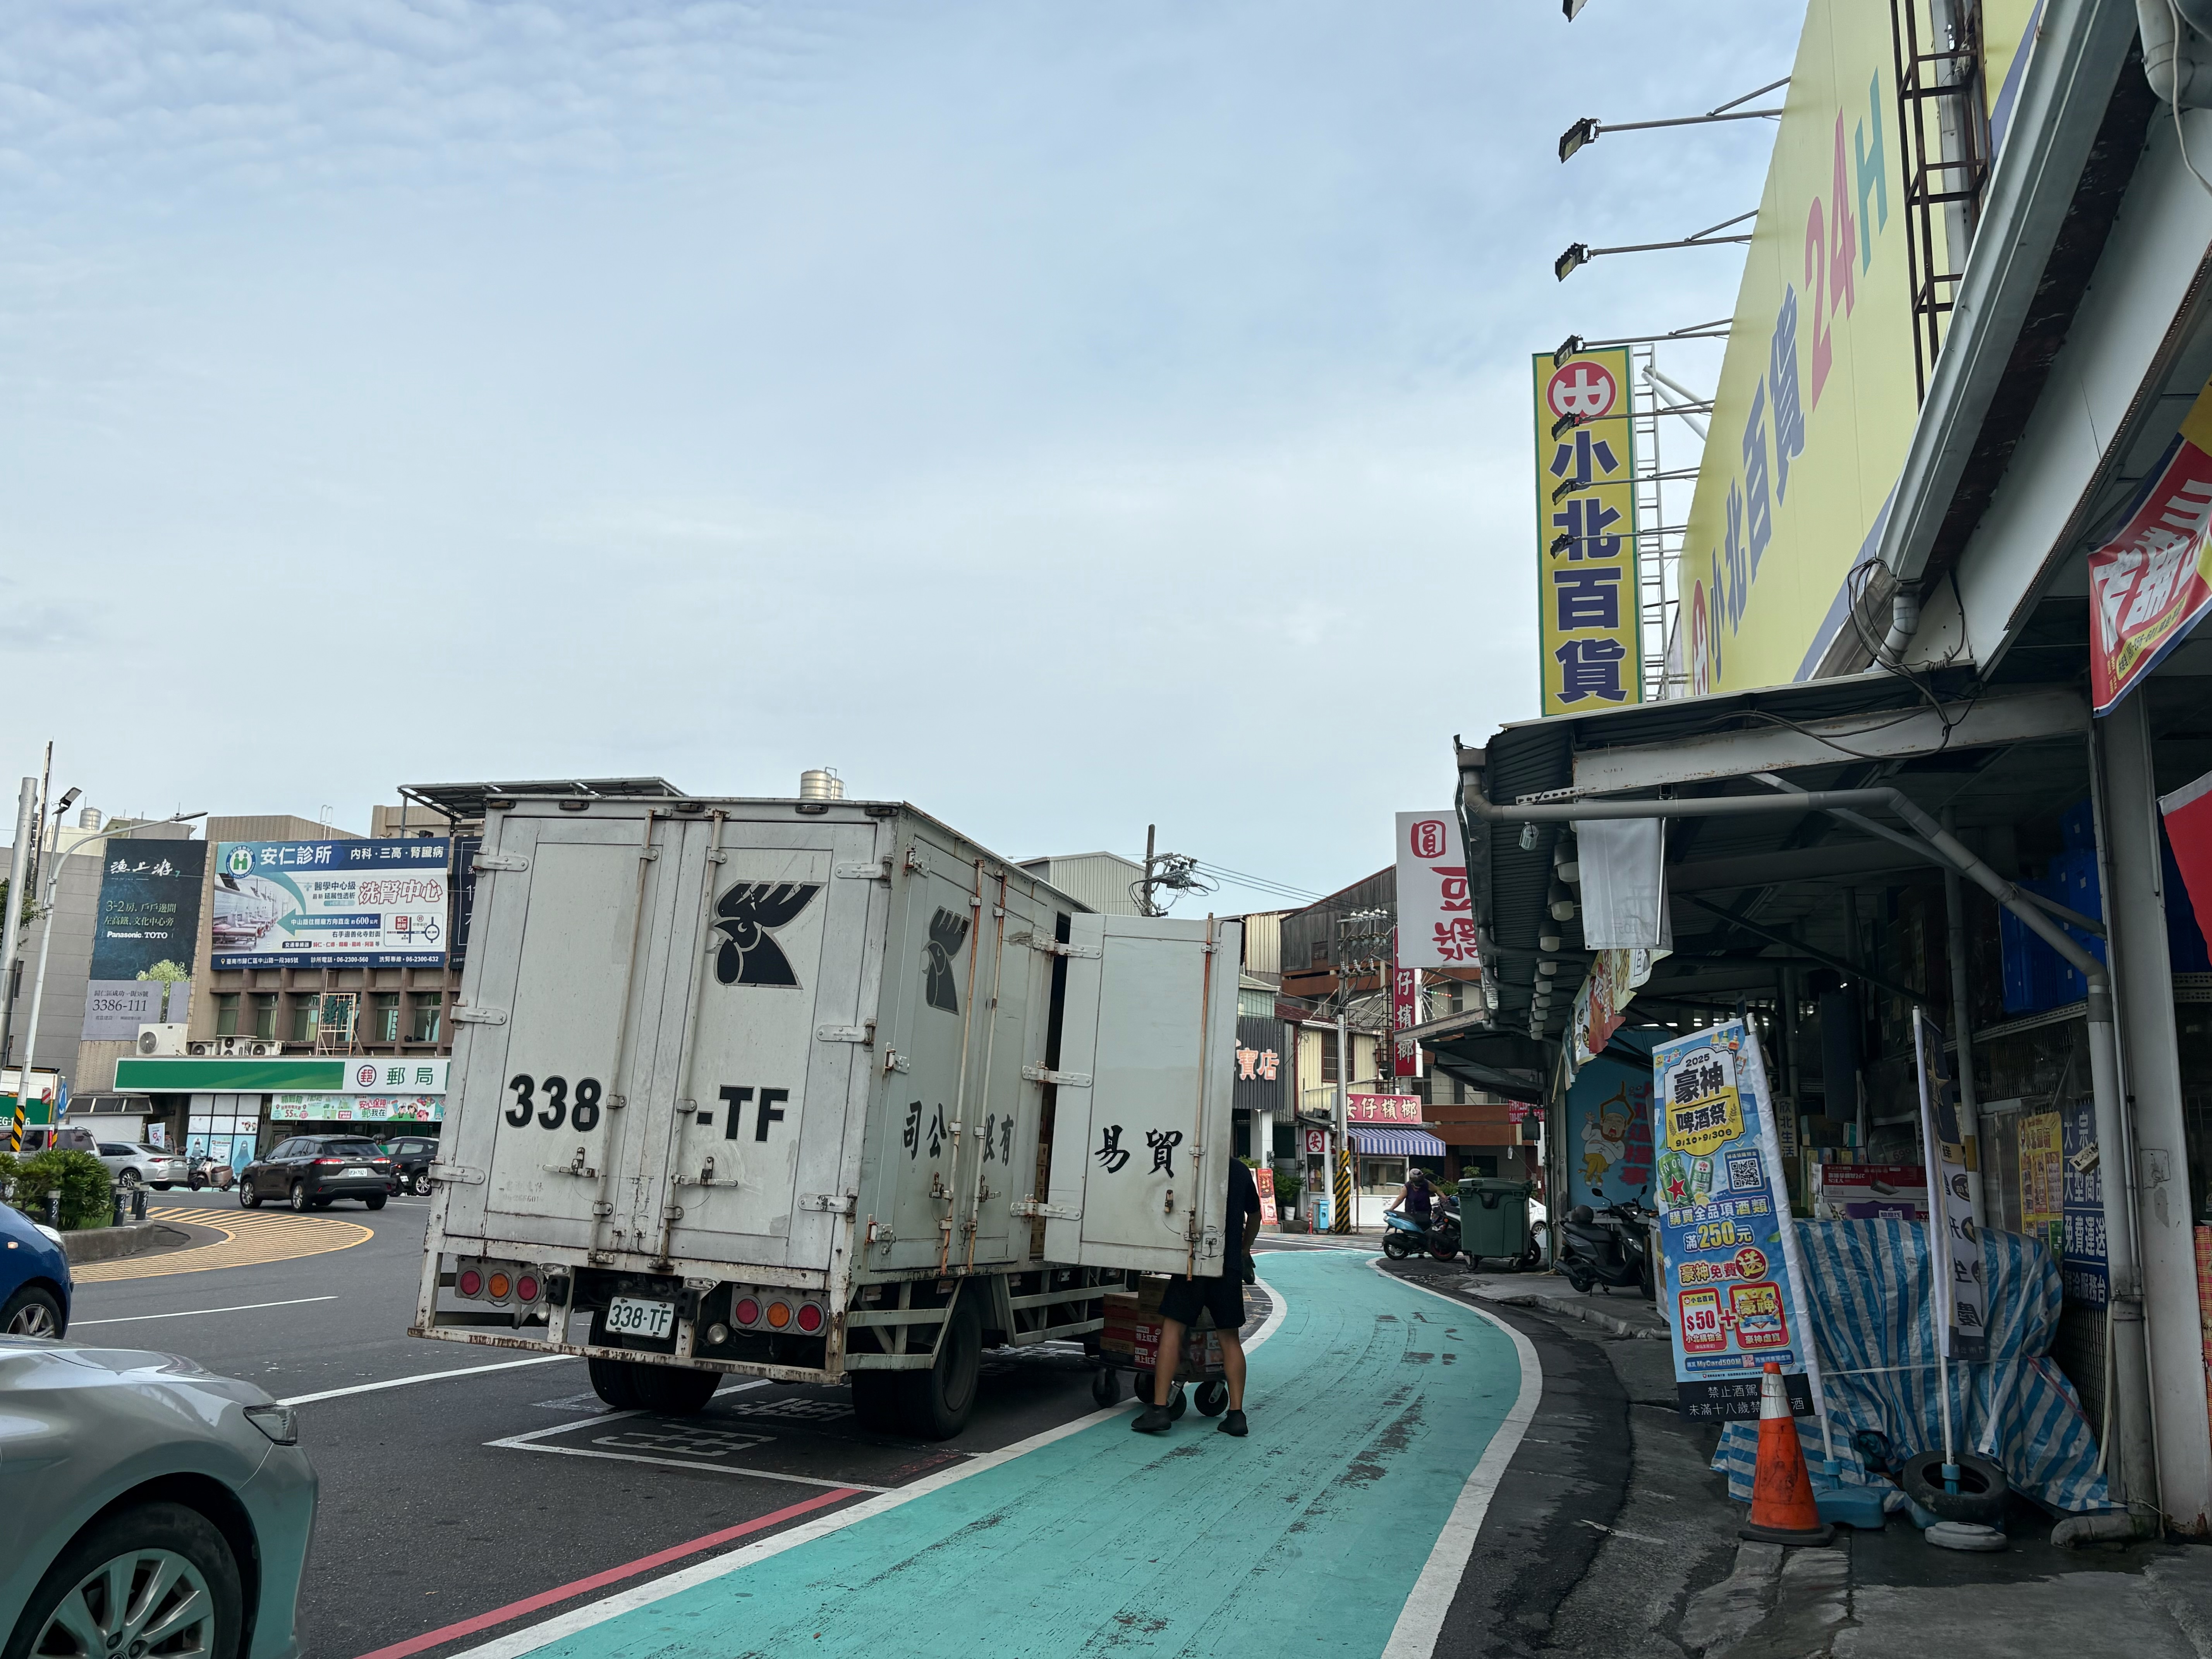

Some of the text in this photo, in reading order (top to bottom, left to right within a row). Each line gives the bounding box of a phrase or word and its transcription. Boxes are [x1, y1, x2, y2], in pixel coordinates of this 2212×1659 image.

[1709, 66, 1889, 681] 小北百貨 24H
[1549, 429, 1629, 705] 小北百貨
[1410, 819, 1446, 859] 圓
[260, 845, 332, 866] 安仁診所
[314, 881, 356, 891] 醫學中心級
[358, 879, 443, 905] 洗腎中心
[92, 999, 147, 1012] 3386-111
[1685, 1053, 1710, 1067] 2025
[386, 1066, 433, 1085] 郵局
[1673, 1061, 1724, 1105] 豪神
[504, 1073, 602, 1132] 338
[1676, 1101, 1727, 1135] 啤酒祭
[1310, 1133, 1321, 1149] 安
[52, 1200, 58, 1218] 22
[1669, 1198, 1770, 1226] 購買全品項酒類
[1685, 1221, 1754, 1251] 滿250元
[2064, 1214, 2106, 1257] 免費運送
[1680, 1250, 1766, 1284] 豪神免費送
[1739, 1298, 1775, 1316] 豪神
[610, 1304, 672, 1332] 338-TF
[1686, 1310, 1716, 1331] $50
[1686, 1332, 1723, 1343] 小北購物金
[1745, 1333, 1781, 1345] 豪神虛寶
[1707, 1384, 1758, 1398] 禁止酒駕
[1689, 1397, 1804, 1417] 未滿十八歲禁酒
